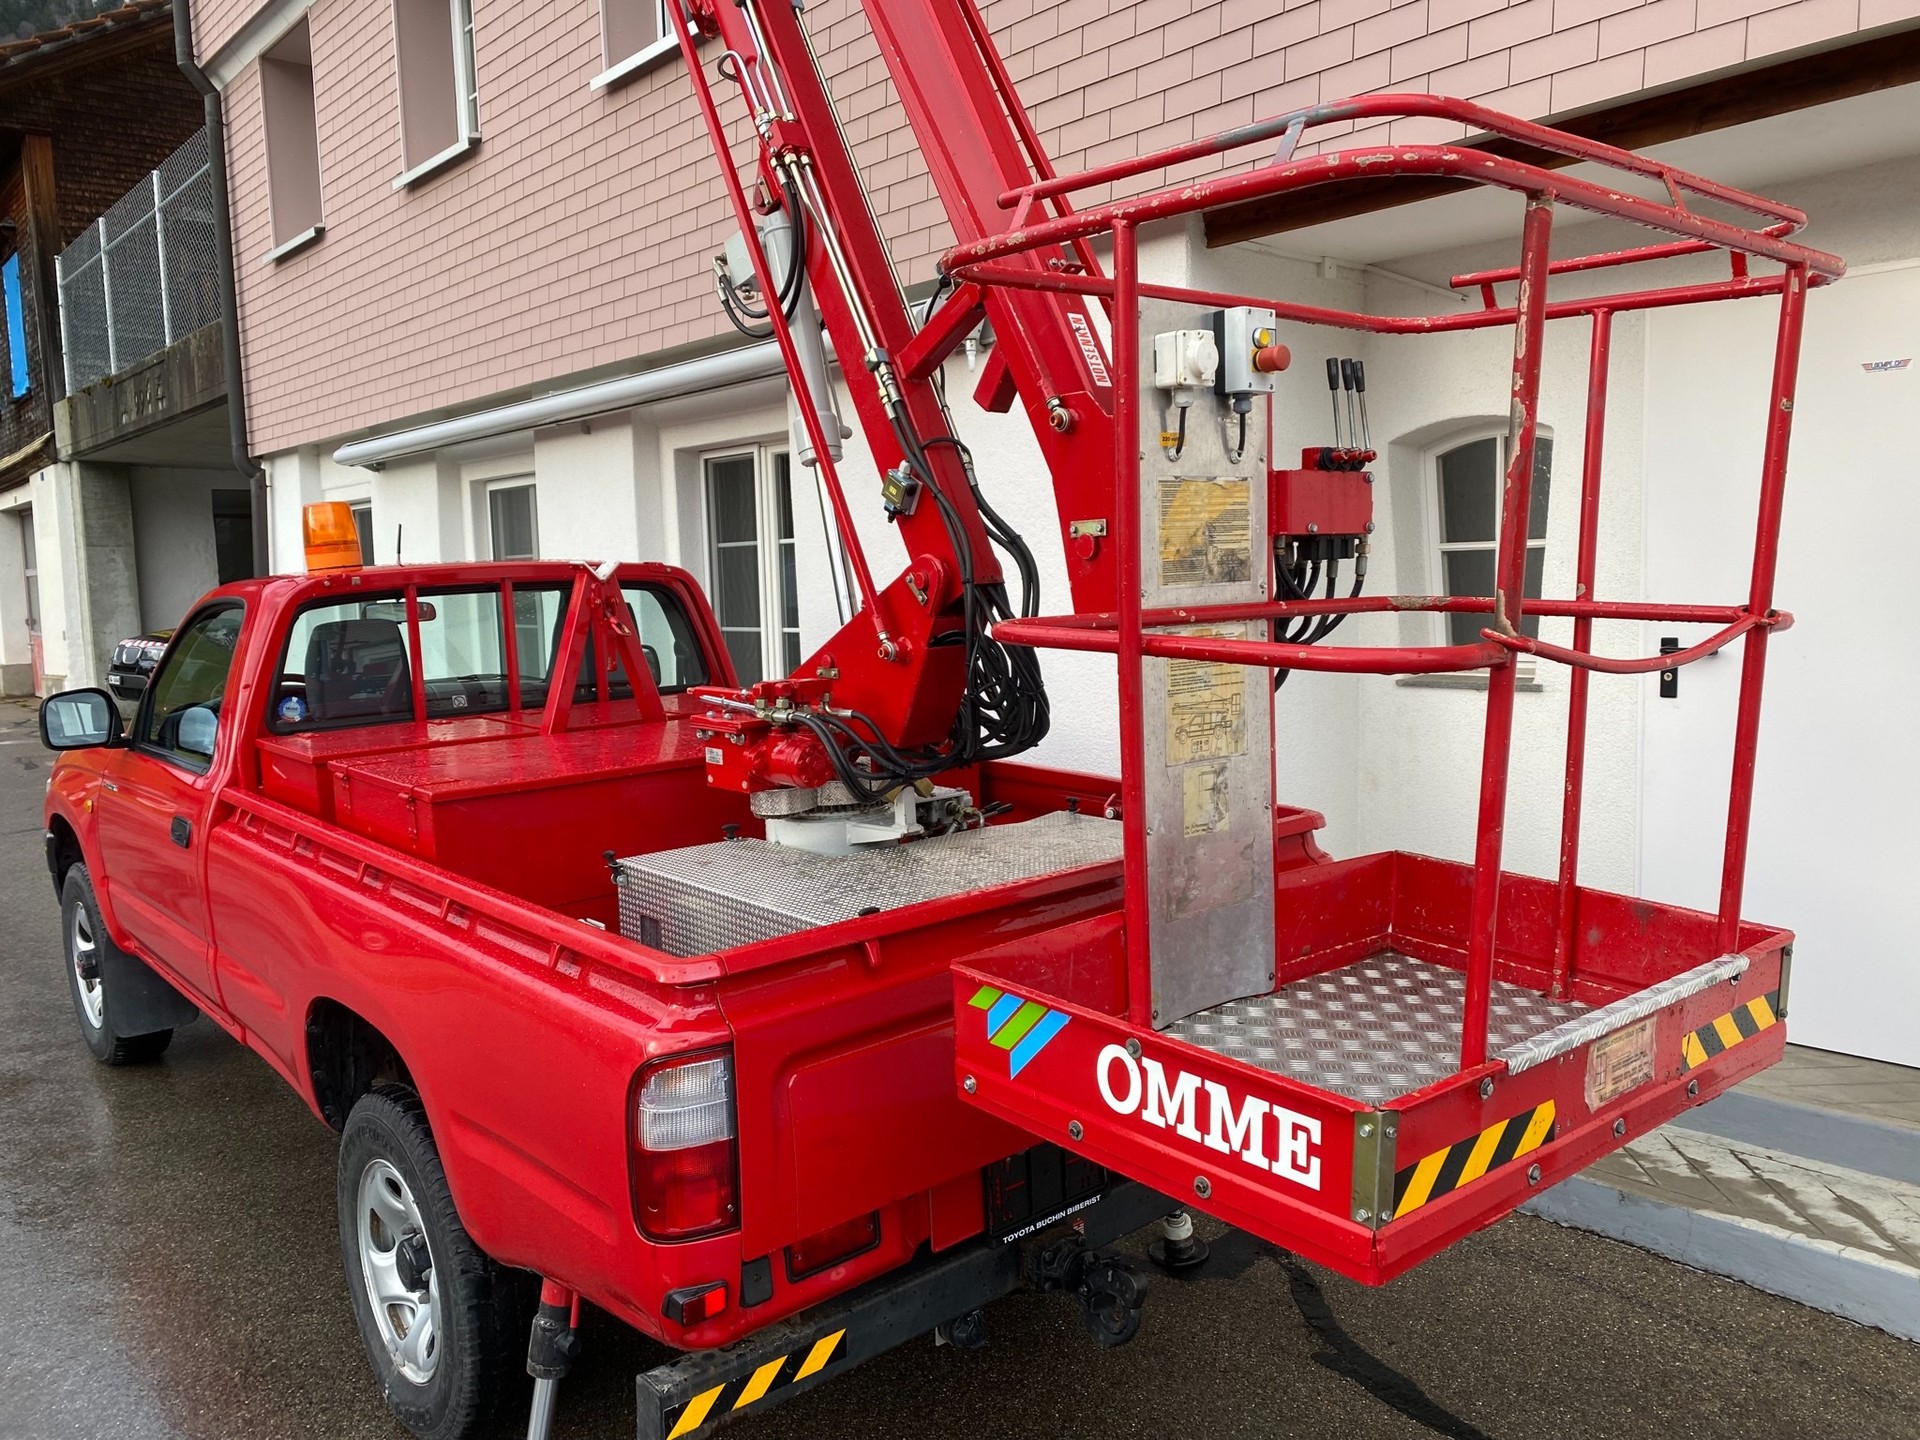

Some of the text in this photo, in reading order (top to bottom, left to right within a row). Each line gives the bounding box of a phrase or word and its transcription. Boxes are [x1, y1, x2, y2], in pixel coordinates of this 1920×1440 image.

[1071, 316, 1108, 383] NOTSENKEN
[1096, 1043, 1322, 1191] OMME
[1003, 1194, 1101, 1244] TOYOTA BUCHIN BIBERIST
